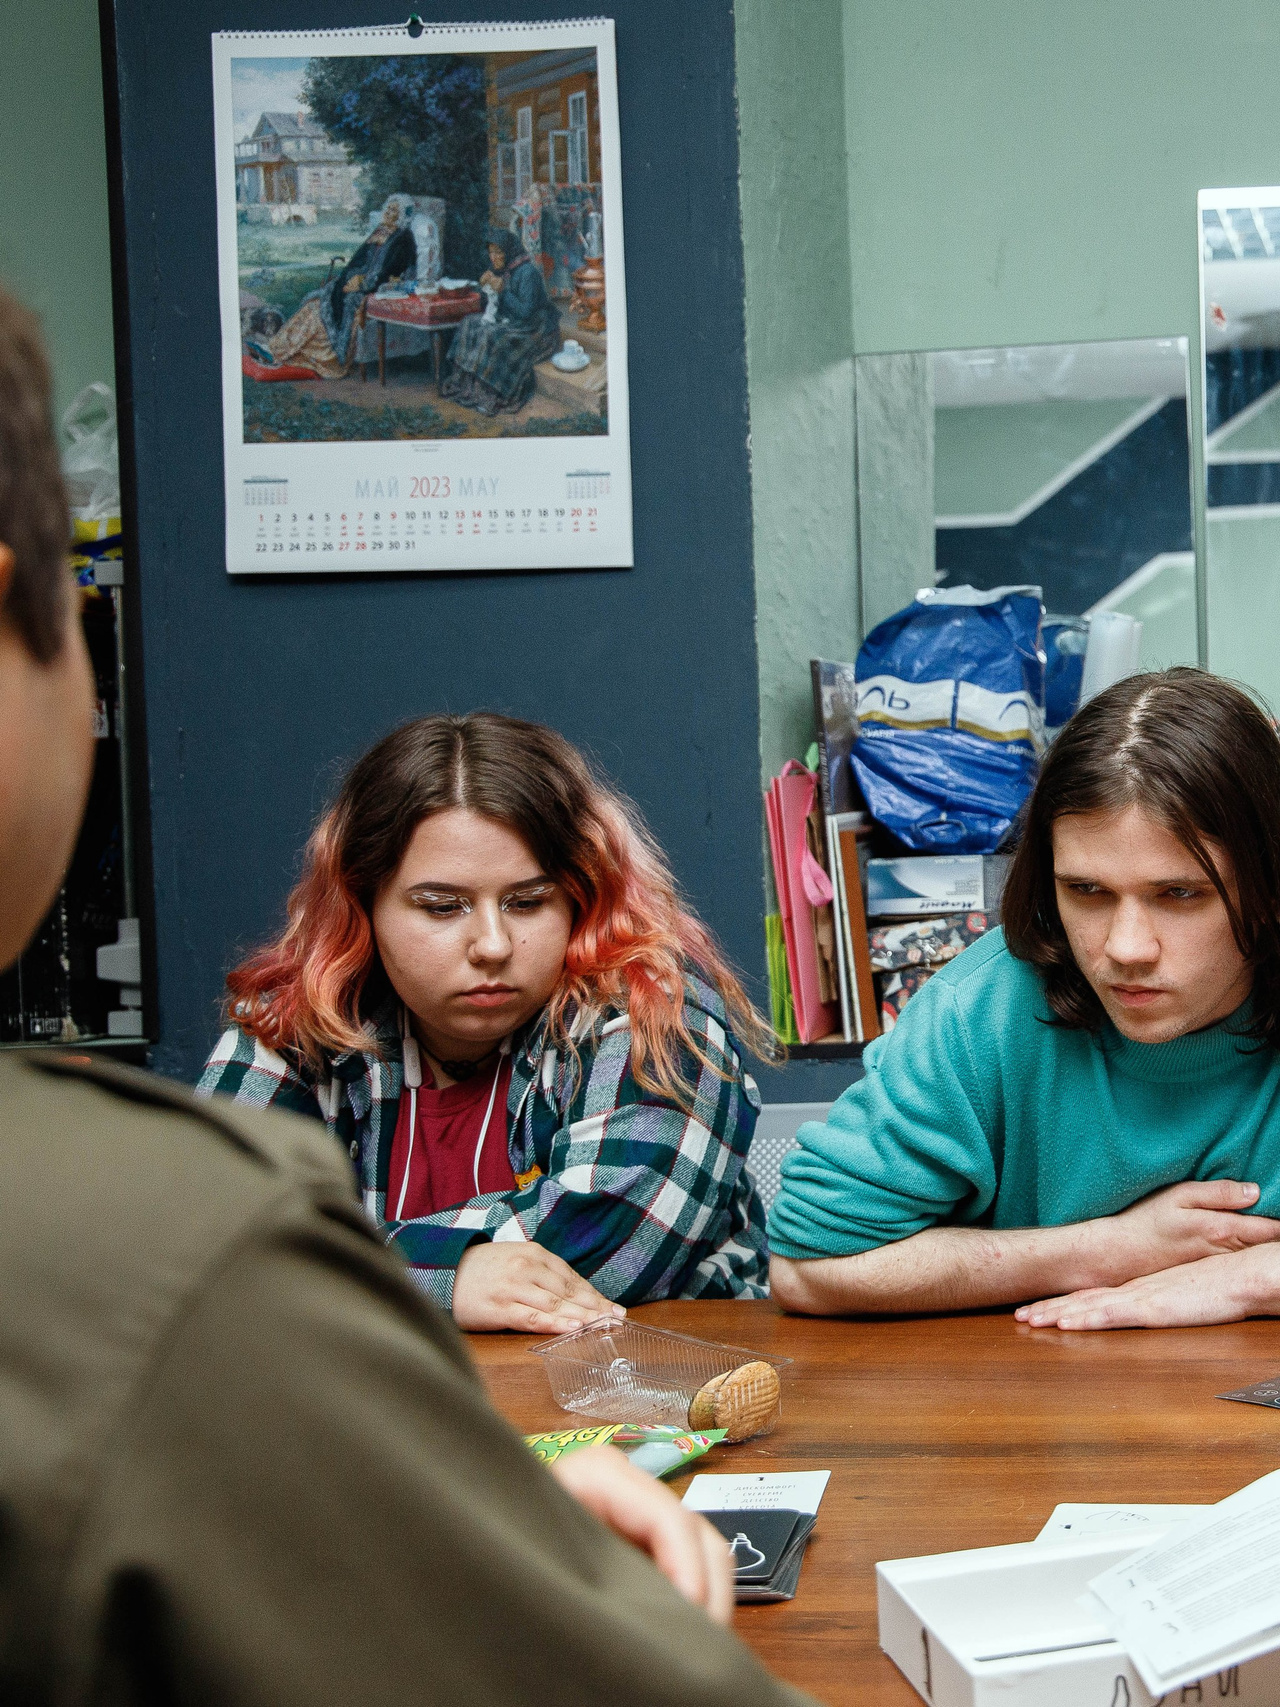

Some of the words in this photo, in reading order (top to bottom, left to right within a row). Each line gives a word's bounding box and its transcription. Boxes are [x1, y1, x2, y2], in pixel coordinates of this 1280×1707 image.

[356, 475, 400, 498] МАЙ
[409, 476, 452, 499] 2023
[459, 477, 500, 497] MAY
[405, 511, 417, 521] 10
[422, 511, 432, 520] 11
[438, 510, 449, 520] 12
[488, 509, 499, 519] 15
[504, 509, 516, 518] 16
[521, 508, 532, 517] 17
[538, 508, 549, 518] 18
[554, 508, 566, 517] 19
[570, 508, 583, 518] 20
[587, 507, 598, 517] 21
[255, 543, 268, 553] 22
[272, 542, 284, 553] 23
[288, 542, 301, 553] 24
[305, 542, 317, 552] 25
[321, 542, 334, 552] 26
[338, 541, 350, 552] 27
[355, 541, 368, 551] 28
[371, 541, 384, 551] 29
[388, 540, 401, 551] 30
[405, 540, 416, 550] 31
